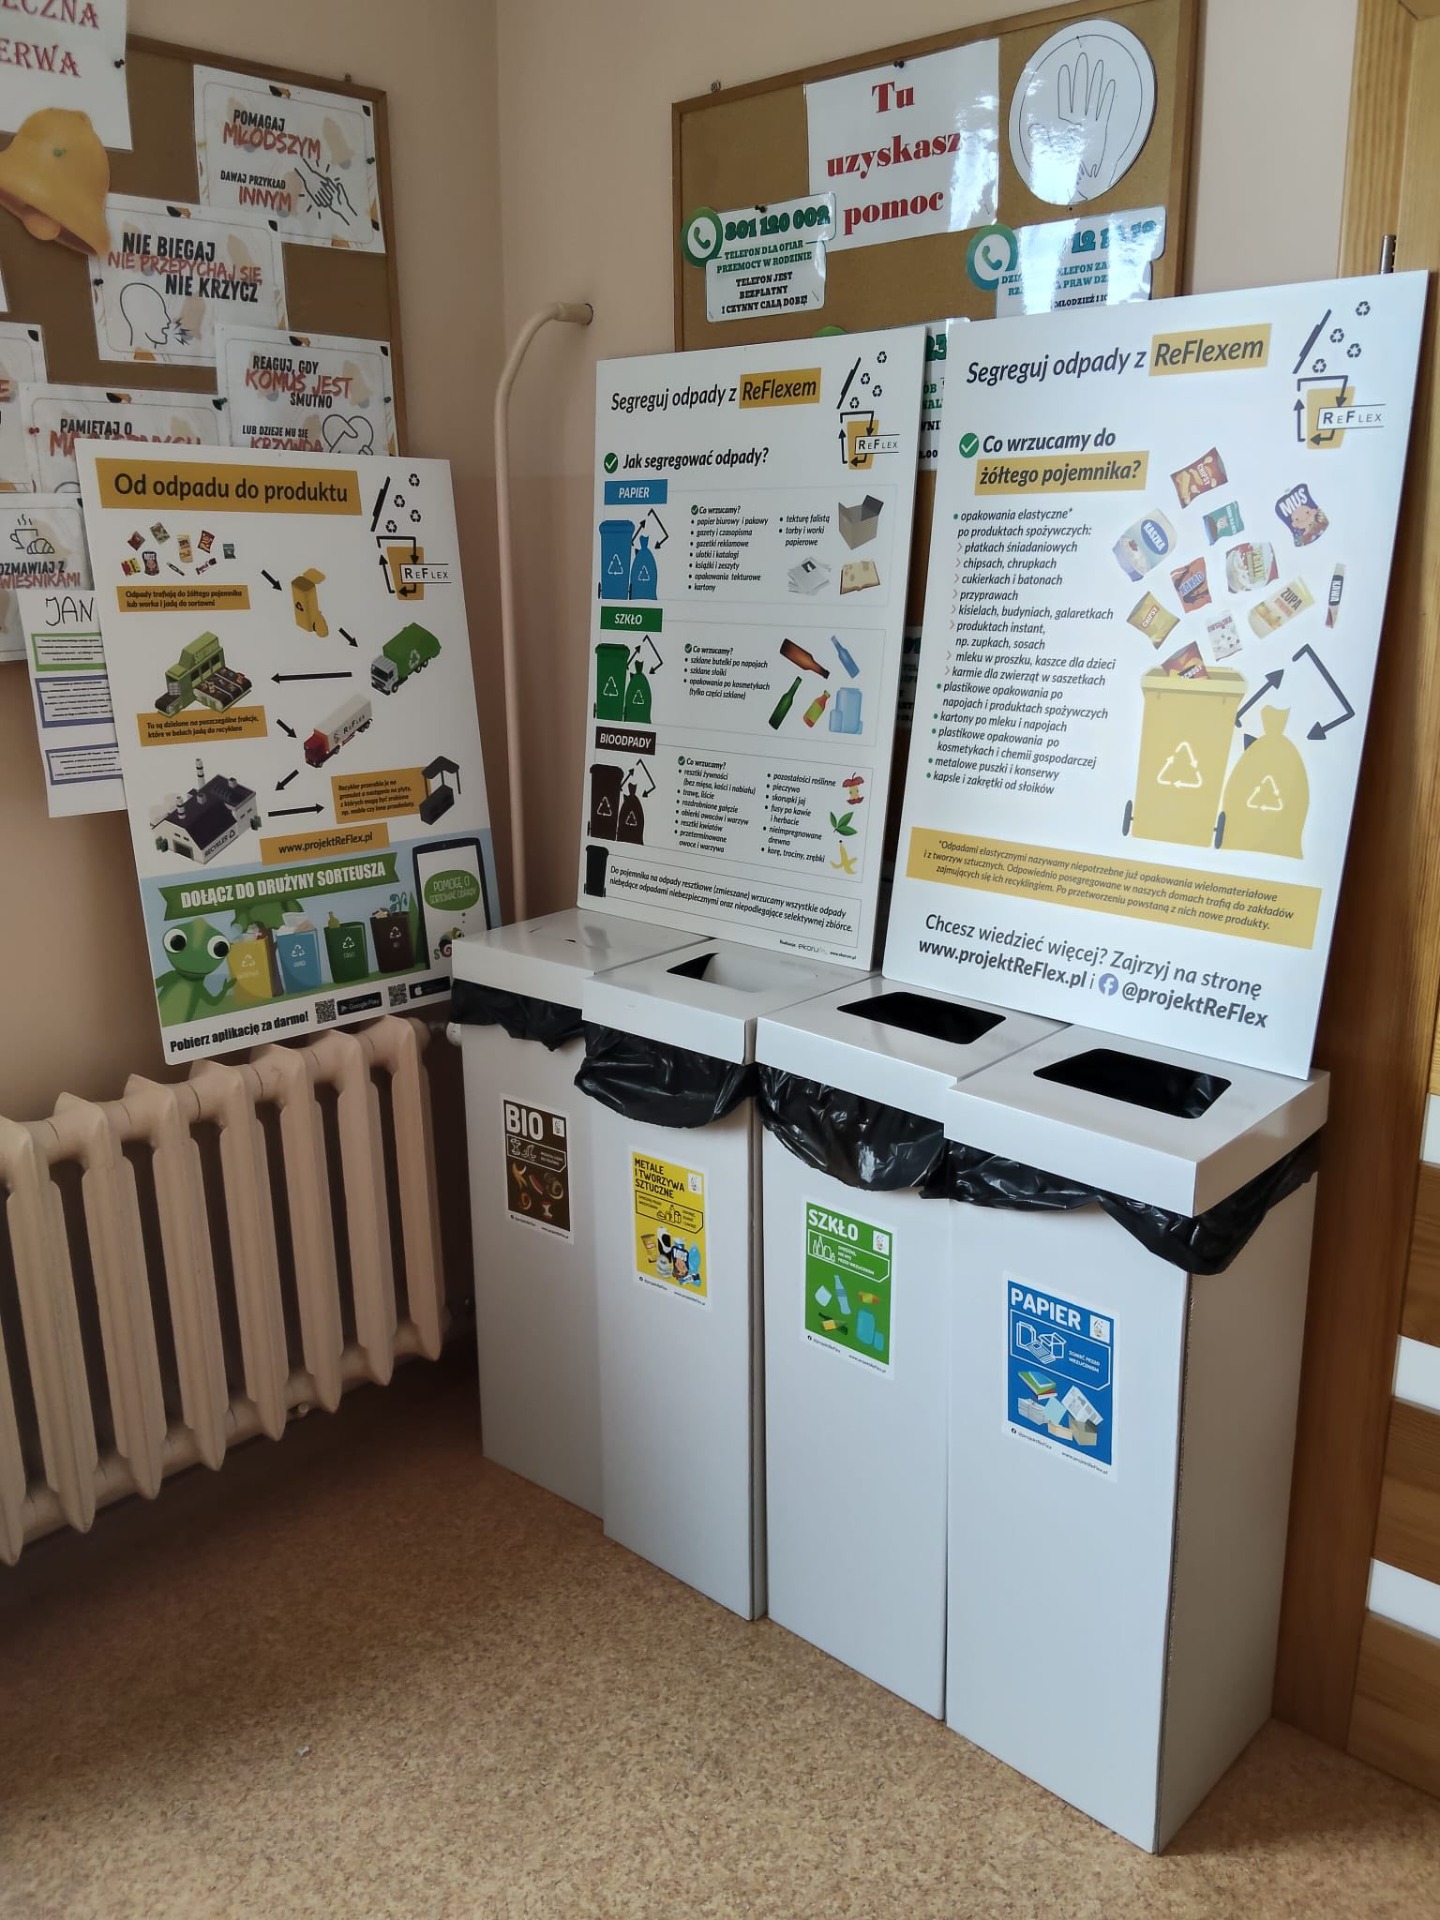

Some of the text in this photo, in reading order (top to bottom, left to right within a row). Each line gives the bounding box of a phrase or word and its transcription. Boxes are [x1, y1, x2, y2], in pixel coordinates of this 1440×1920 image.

[872, 81, 915, 114] Tu
[233, 109, 285, 132] POMAGAJ
[222, 122, 321, 160] MŁODSZYM
[826, 131, 962, 179] uzyskasz
[220, 170, 286, 190] DAWAJ PRZYKŁAD
[238, 186, 292, 212] INNYM
[725, 205, 831, 240] 801 120 002
[843, 191, 944, 236] pomoc
[122, 232, 215, 262] NIE BIEGAJ
[724, 240, 803, 260] TELEFON DLA OFIAR
[108, 251, 262, 285] NIE PRZEPYCHAJ SIĘ
[717, 251, 812, 274] PRZEMOCY W RODZINIE
[166, 274, 258, 302] NIE KRZYCZ
[736, 272, 793, 287] TELEFON JEST
[1064, 276, 1092, 289] PRAW
[740, 285, 788, 299] BEZPŁATNY
[722, 306, 725, 314] I
[726, 302, 759, 314] CZYNNY
[760, 299, 782, 310] CAŁĄ
[253, 356, 319, 374] REAGUJ, GDY
[966, 337, 1264, 386] Segreguj odpady z ReFlexem
[246, 369, 352, 396] KOMUŚ JEST
[290, 393, 332, 409] SMUTNO
[611, 378, 816, 413] Segreguj odpady z ReFlexem
[60, 418, 132, 436] PAMIĘTAJ O
[242, 425, 308, 438] LUB DZIEJE MU SIĘ
[983, 429, 1116, 454] Co wrzucamy do
[623, 447, 769, 469] Jak segregować odpady?
[980, 458, 1141, 487] żółtego pojemnika?
[114, 472, 348, 504] Od odpadu do produktu
[619, 486, 650, 499] PAPIER
[1279, 488, 1308, 517] MUS
[961, 509, 1016, 522] opakowania
[958, 524, 1092, 538] po produktach spożywczych:
[965, 541, 1078, 554] płatkach śniadaniowych
[59, 561, 64, 573] Z
[963, 558, 1057, 570] chipsach, chrupkach
[962, 574, 1062, 585] cukierkach i batonach
[960, 590, 1018, 601] przyprawach
[1280, 587, 1303, 611] ZUPA
[45, 597, 93, 626] JAN
[615, 613, 642, 625] SZKŁO
[958, 605, 1114, 620] kisielach, budyniach, galaretkach
[956, 620, 1046, 634] produktach instant,
[956, 636, 1045, 650] np. zupkach, sosach
[956, 652, 1116, 670] mleku w proszku, kaszce dla dzieci
[952, 667, 1106, 686] karmie dla zwierząt w saszetkach
[943, 682, 1063, 701] plastikowe opakowania po
[600, 733, 652, 749] BIOODPADY
[278, 832, 373, 854] www.projektReFlex.pl
[181, 861, 386, 910] DOŁĄCZ DO DRUŻYNY SORTEUSZA
[611, 865, 619, 875] Do
[620, 868, 649, 881] pojemnika
[659, 875, 681, 887] odpady
[713, 884, 750, 900] (zmieszane)
[751, 893, 785, 907] wrzucamy
[785, 898, 818, 912] wszystkie
[819, 905, 846, 918] odpady
[925, 913, 1262, 1000] Chcesz wiedzieć więcej? Zajrzyj na stronę
[918, 938, 1269, 1029] www.projektReFlex.pl i @projektReFlex
[170, 1011, 309, 1052] Pobierz aplikację za darmo!
[506, 1103, 544, 1141] BIO
[635, 1158, 664, 1175] METALE
[635, 1168, 685, 1192] I TWORZYWA
[636, 1178, 674, 1199] SZTUCZNE
[808, 1209, 858, 1241] SZKŁO
[1011, 1287, 1081, 1331] PAPIER
